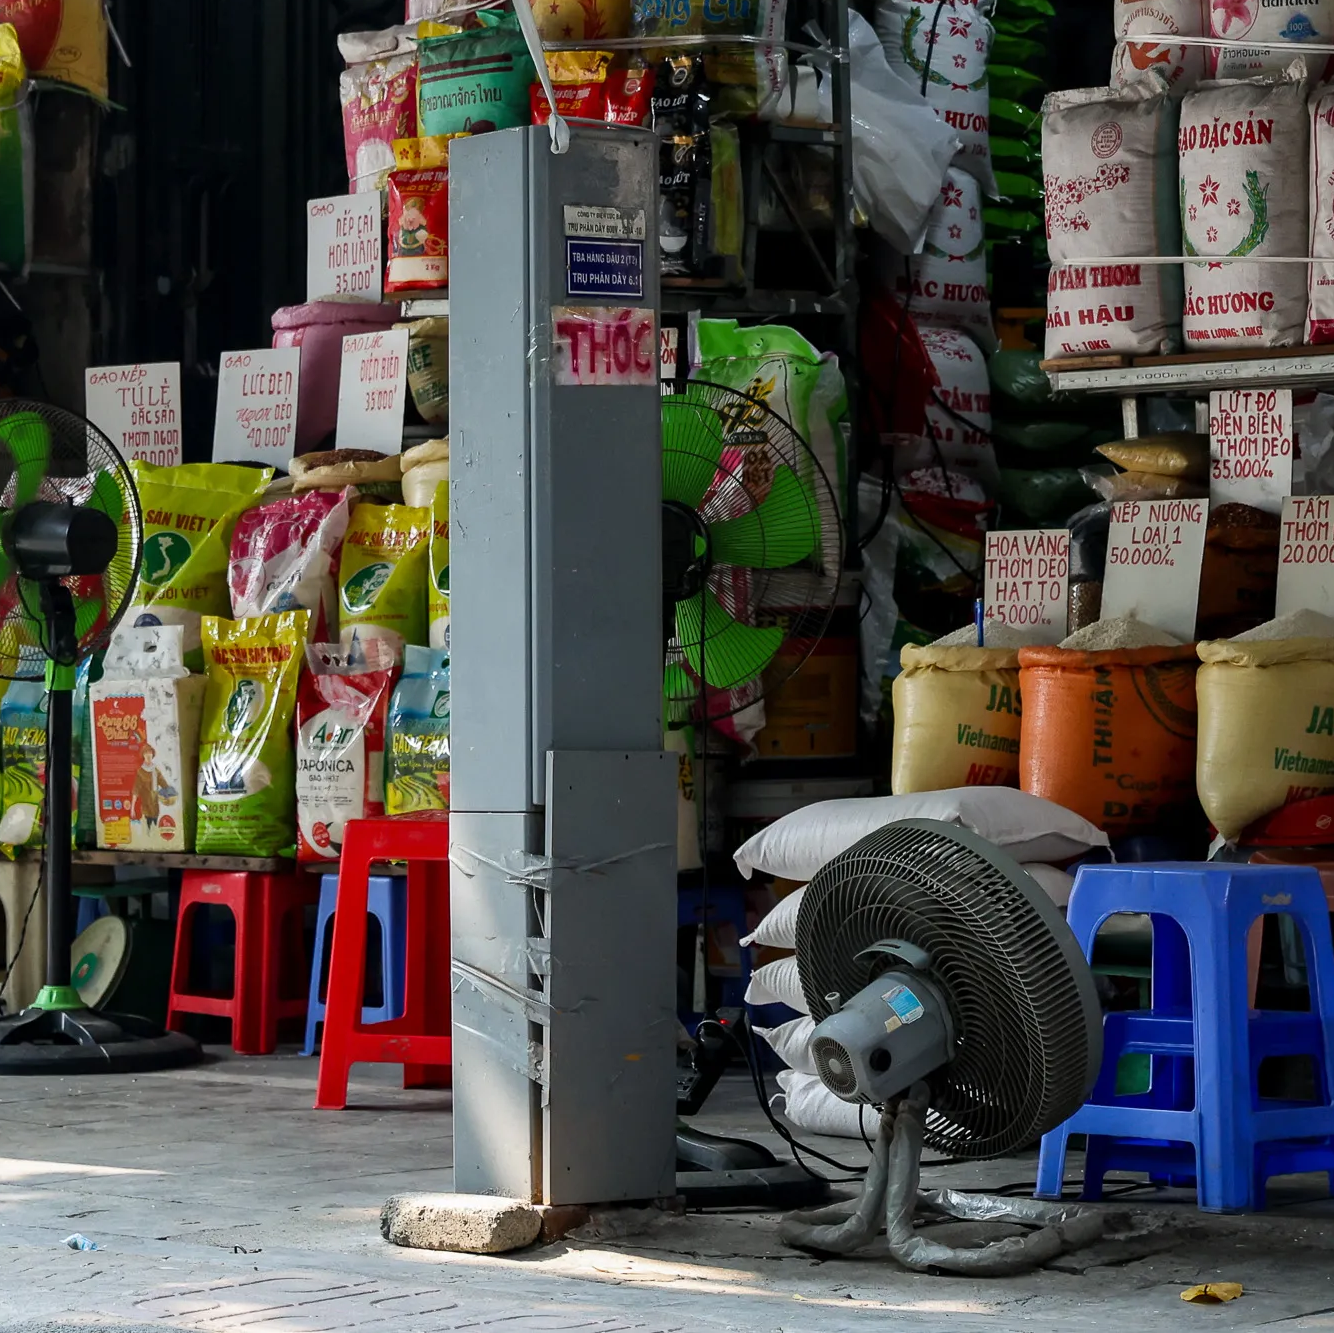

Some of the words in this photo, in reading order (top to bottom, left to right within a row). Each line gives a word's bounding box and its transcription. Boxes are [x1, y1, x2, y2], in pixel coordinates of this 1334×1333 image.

[1199, 116, 1229, 153] ĐẶC
[1232, 110, 1274, 146] SẢN
[572, 252, 586, 263] TBA
[589, 271, 610, 284] PHÂN
[1208, 290, 1275, 315] HƯƠNG
[1078, 304, 1135, 327] HẬU
[1241, 325, 1263, 337] 10KG
[1084, 339, 1111, 350] 10KG
[1217, 438, 1258, 458] THƠM
[1110, 501, 1141, 523] NẾP
[1172, 526, 1182, 544] 1
[1283, 521, 1329, 542] THƠM
[987, 536, 1019, 557] HOA
[1024, 530, 1069, 557] VÀNG
[985, 557, 1033, 579] THƠM
